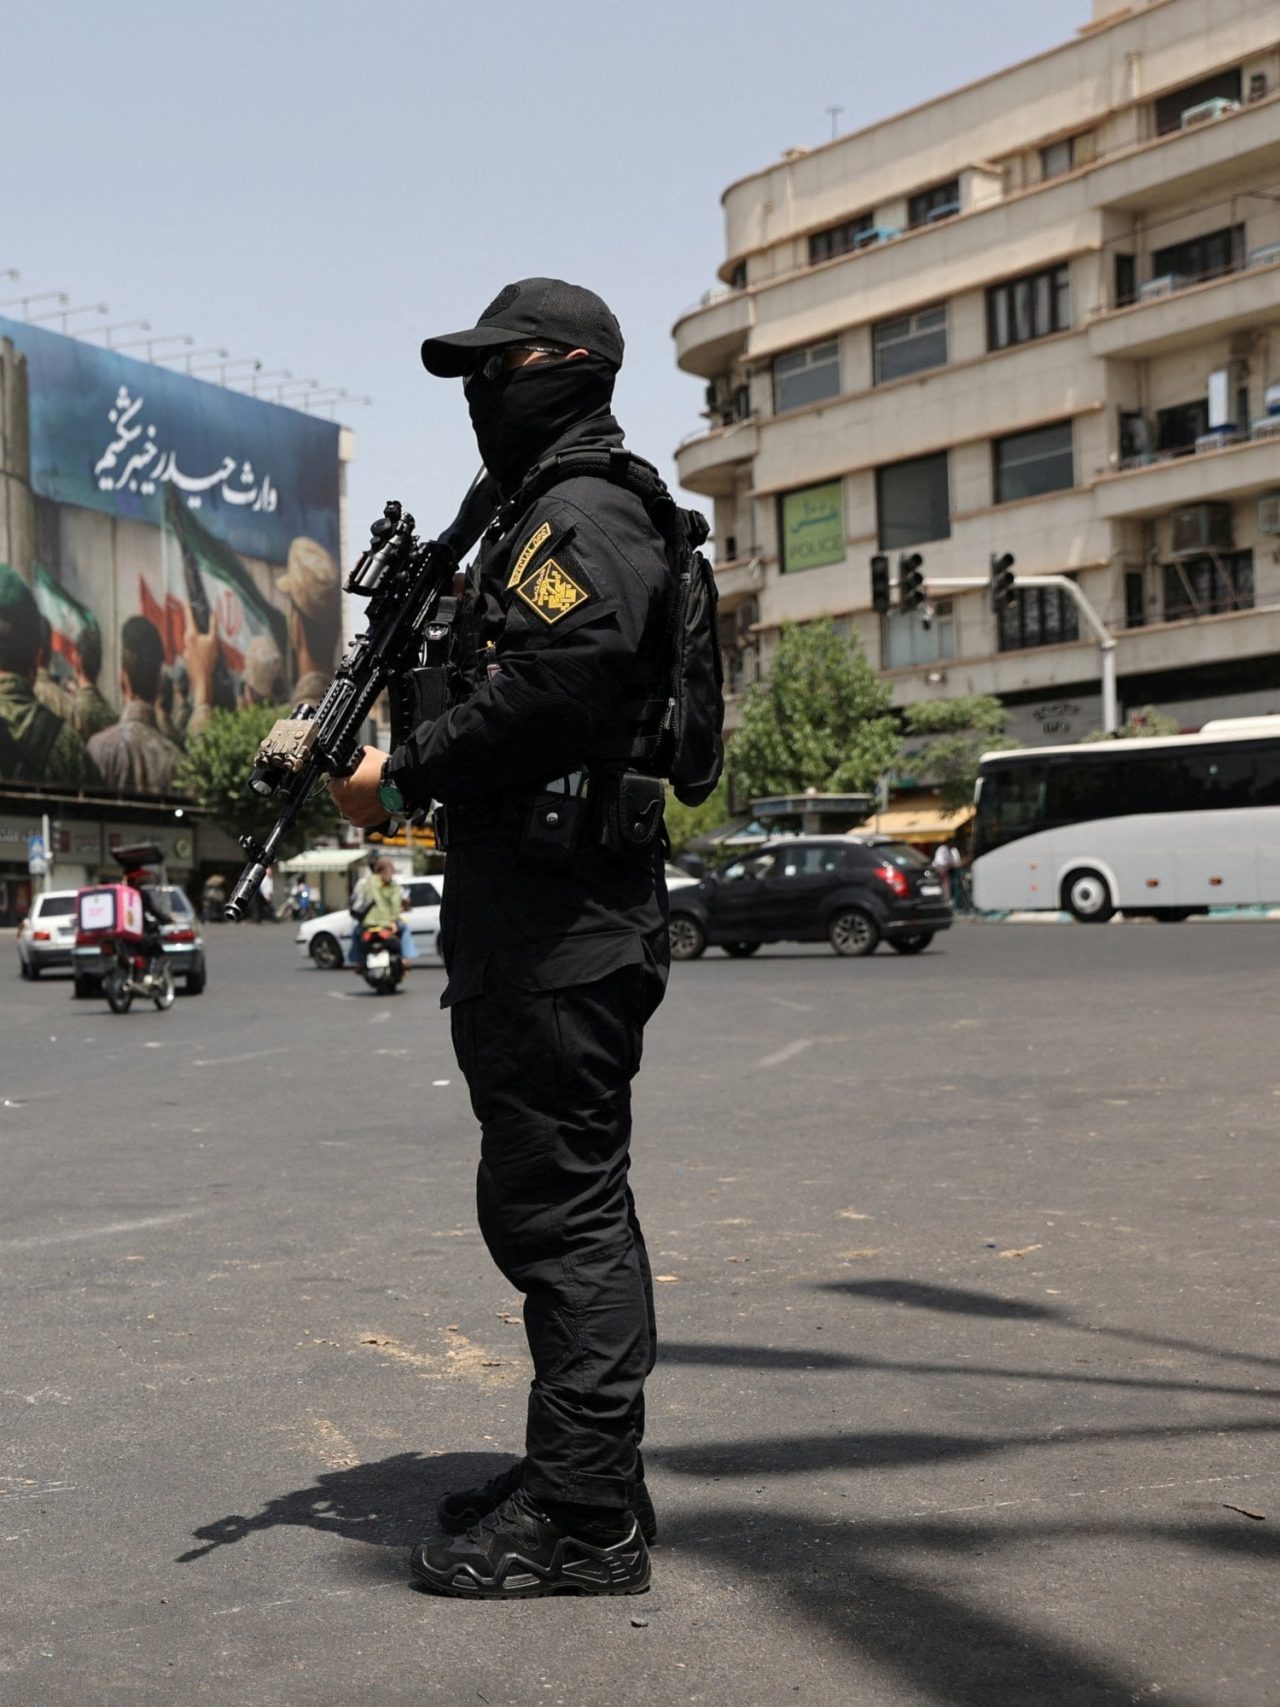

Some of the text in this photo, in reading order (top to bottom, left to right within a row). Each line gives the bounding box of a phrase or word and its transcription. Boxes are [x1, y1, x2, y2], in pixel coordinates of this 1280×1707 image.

[150, 451, 237, 510] حیدر
[222, 461, 278, 512] وارث
[532, 526, 549, 547] OPS
[787, 533, 843, 560] POLICE
